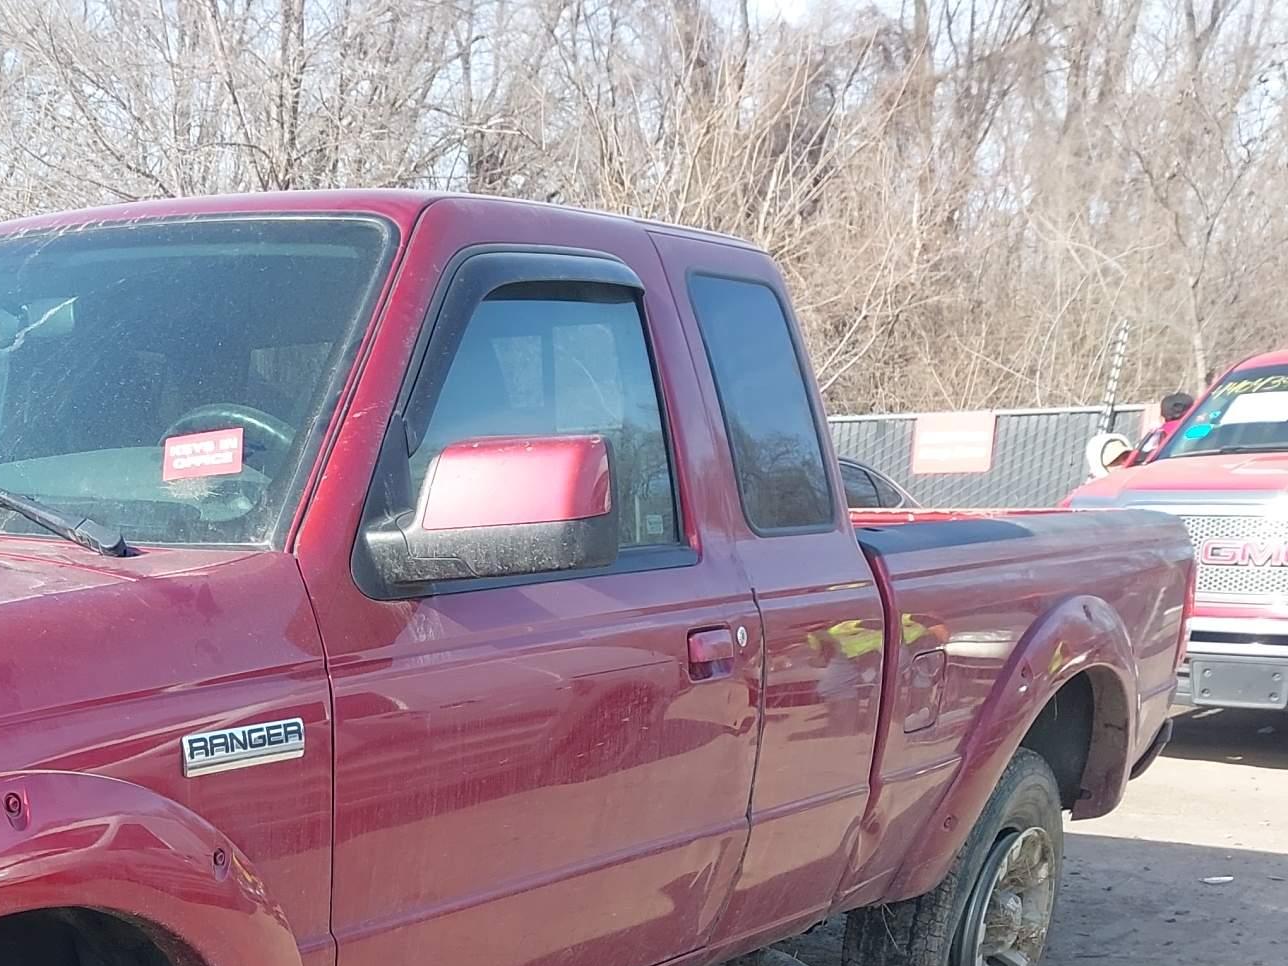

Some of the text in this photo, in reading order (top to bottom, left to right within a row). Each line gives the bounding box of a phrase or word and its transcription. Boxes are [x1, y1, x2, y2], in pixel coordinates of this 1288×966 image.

[218, 437, 238, 450] IN
[1200, 538, 1288, 567] GM
[188, 721, 303, 760] RANGER
